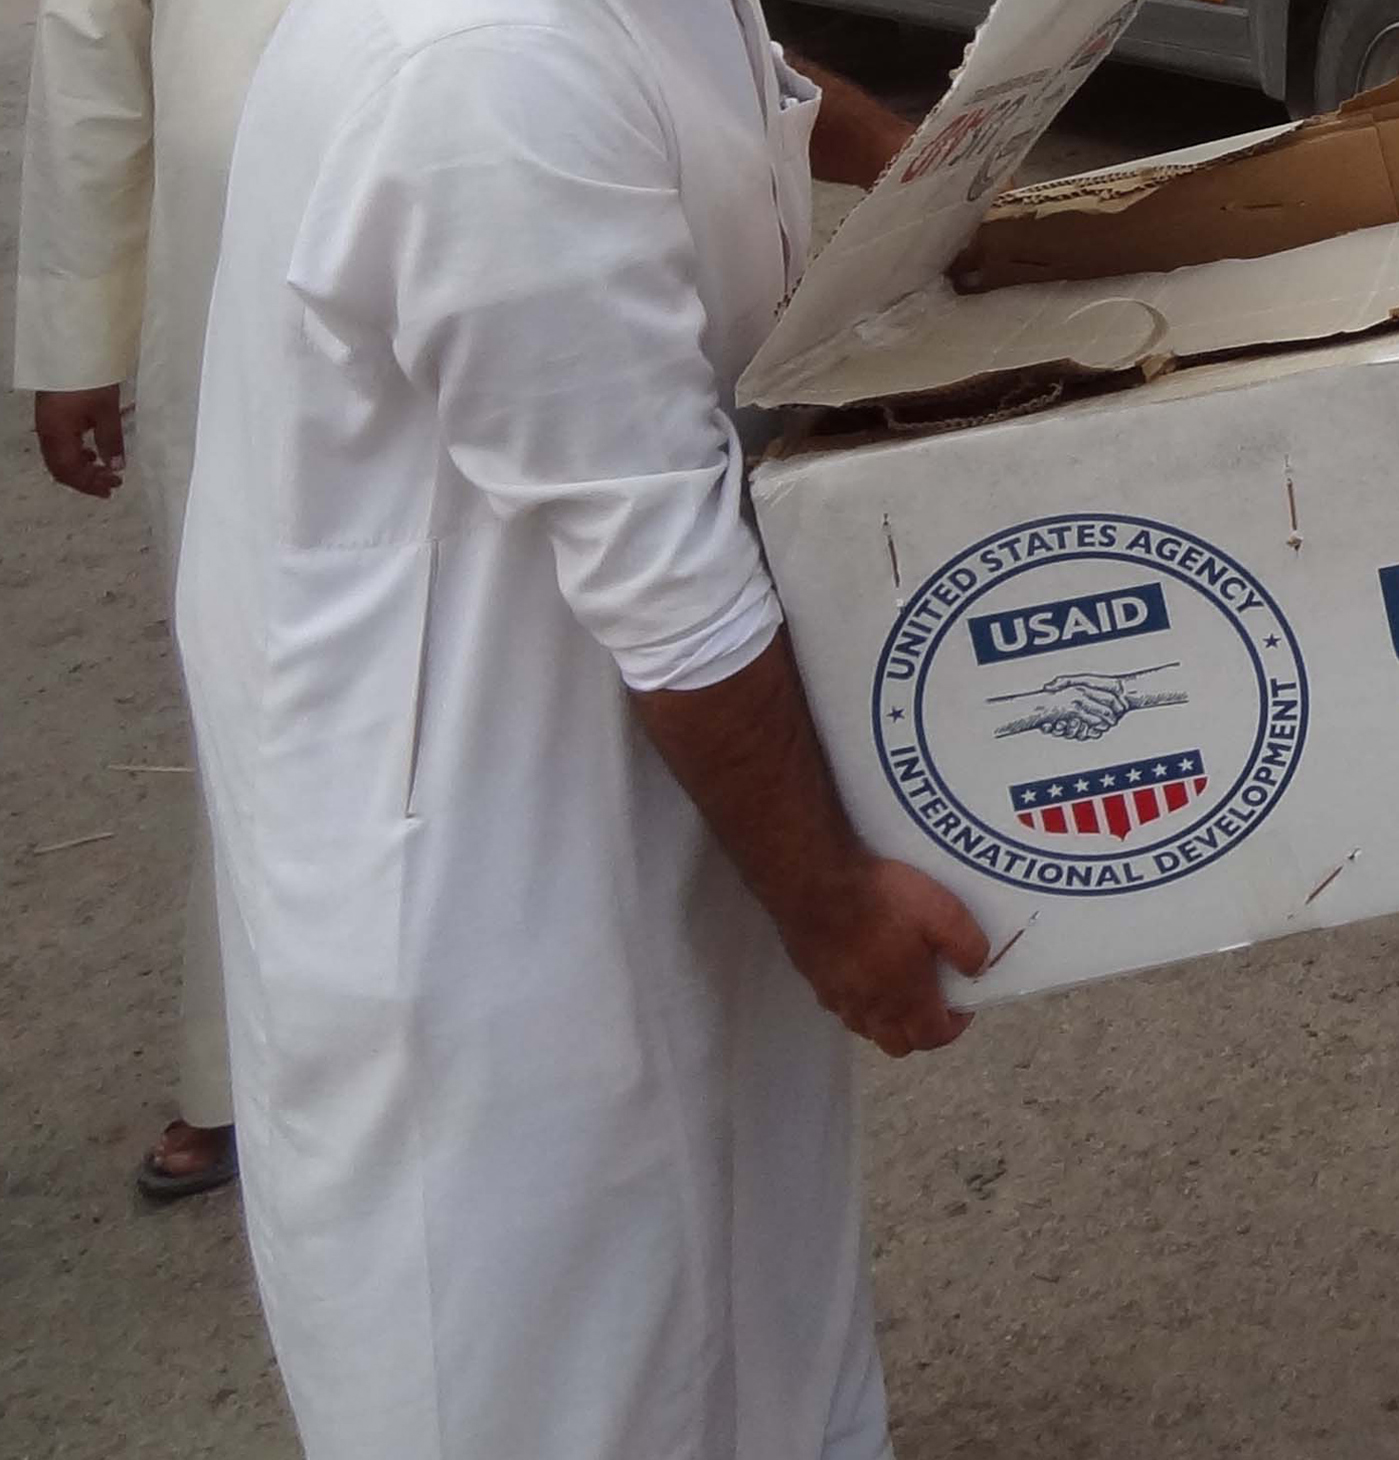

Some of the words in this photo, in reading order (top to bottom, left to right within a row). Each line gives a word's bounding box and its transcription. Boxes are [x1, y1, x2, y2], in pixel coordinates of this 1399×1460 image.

[885, 567, 978, 681] UNITED
[979, 523, 1118, 574] STATES
[1126, 529, 1265, 614] AGENCY
[989, 596, 1150, 653] USAID
[889, 745, 1145, 888] INTERNATIONAL
[1156, 677, 1297, 875] DEVELOPMENT
